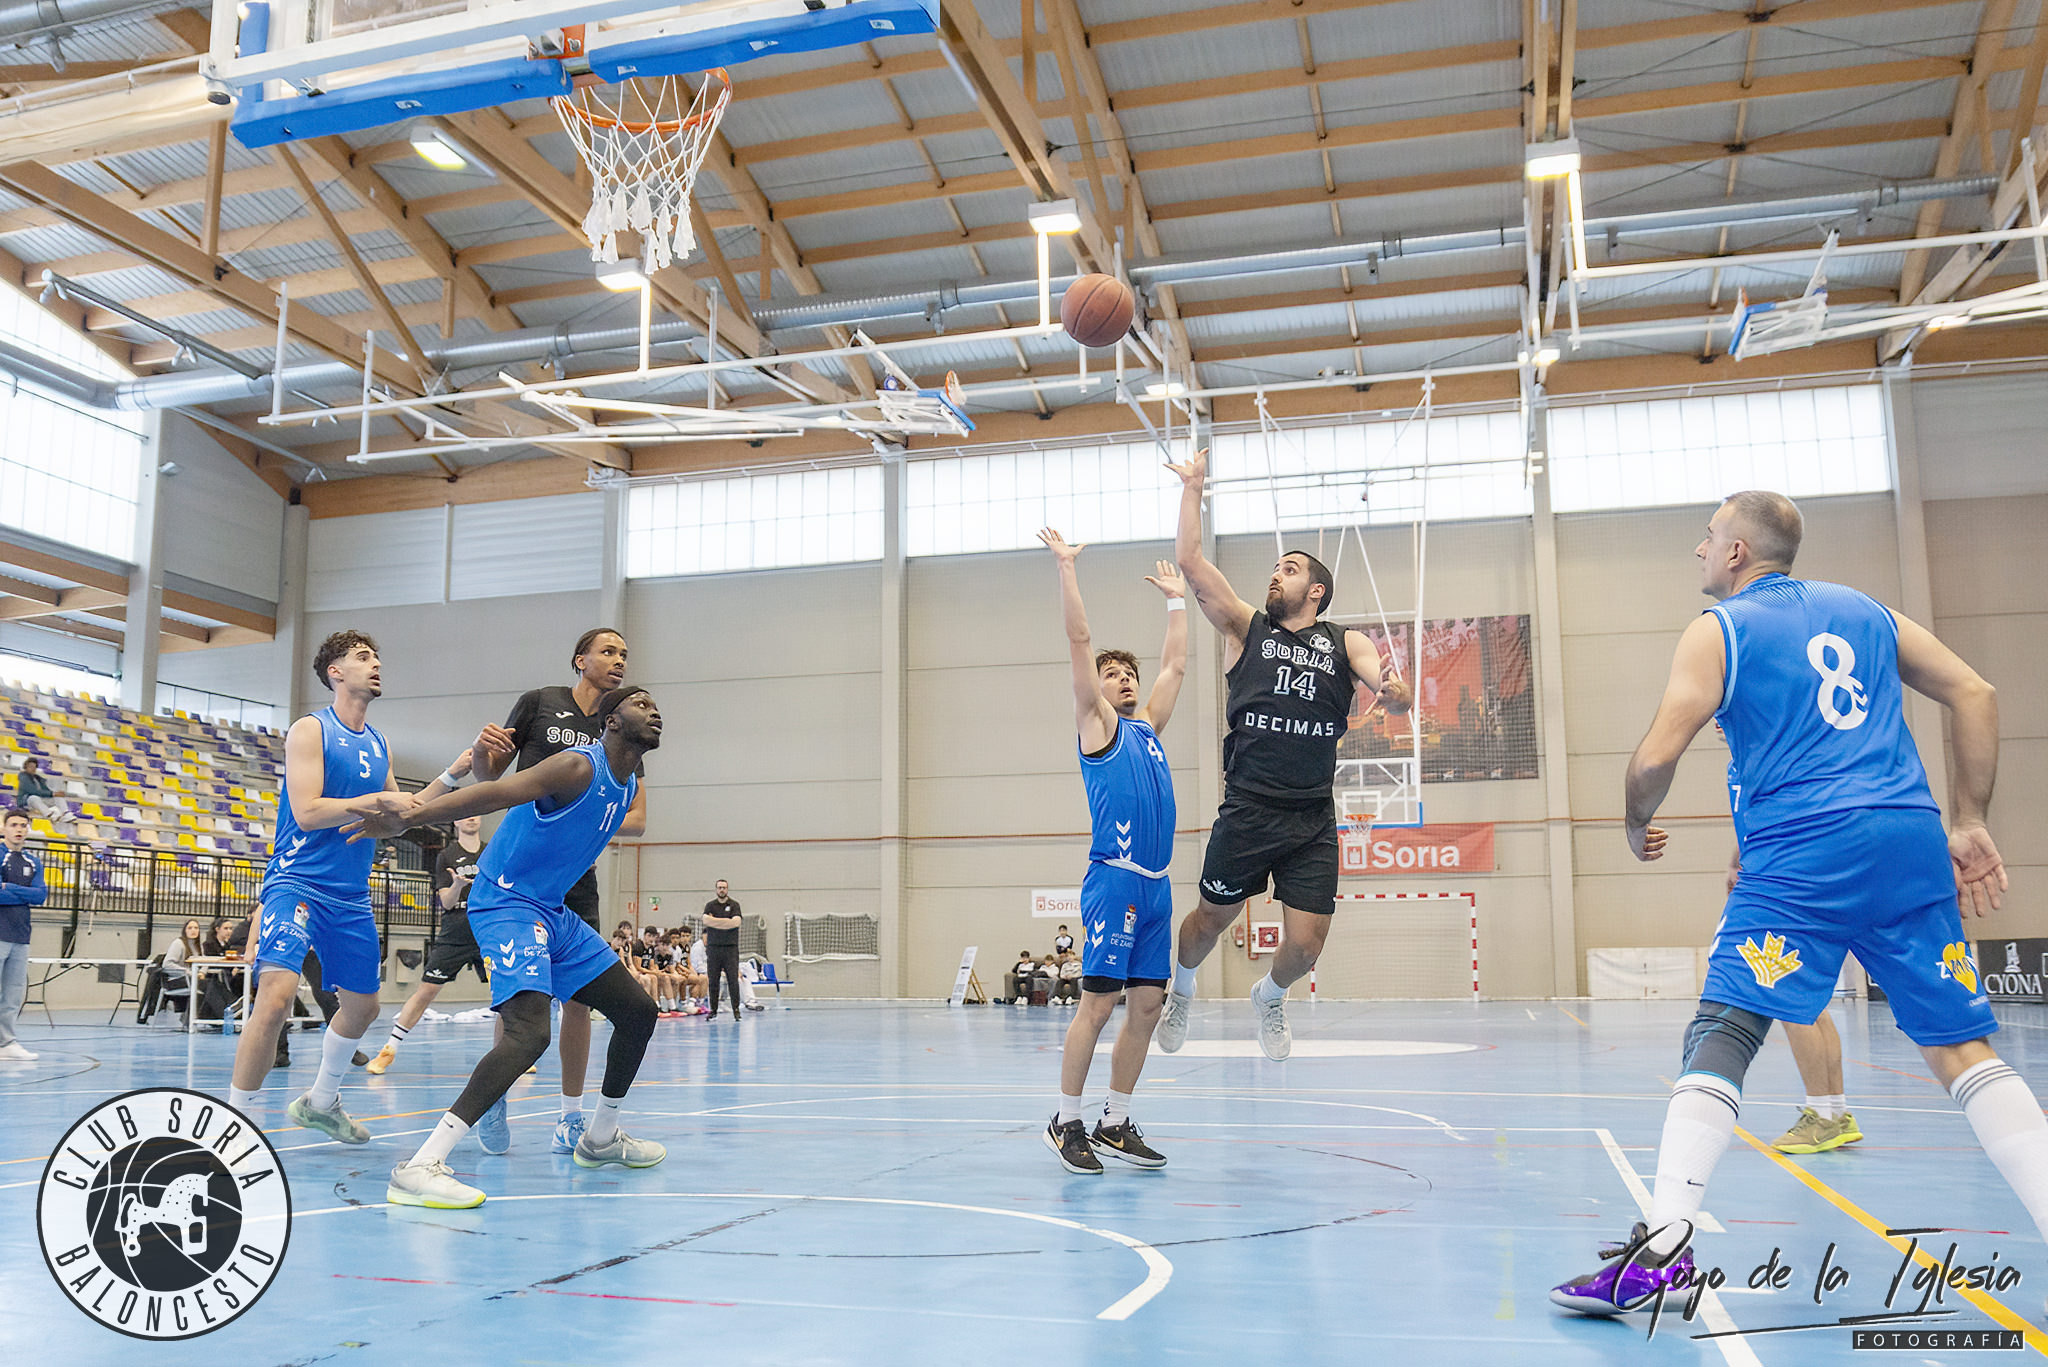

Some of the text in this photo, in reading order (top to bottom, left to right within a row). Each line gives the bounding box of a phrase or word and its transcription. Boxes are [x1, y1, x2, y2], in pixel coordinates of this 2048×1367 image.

[1261, 639, 1336, 676] SORIA
[1273, 665, 1317, 701] 14
[1807, 632, 1868, 730] 8
[1244, 711, 1335, 737] DECIMAS
[359, 750, 371, 779] 5
[599, 802, 618, 832] 11
[1372, 840, 1460, 869] Soria
[1047, 899, 1081, 911] Soria
[1984, 973, 2043, 995] CYONA
